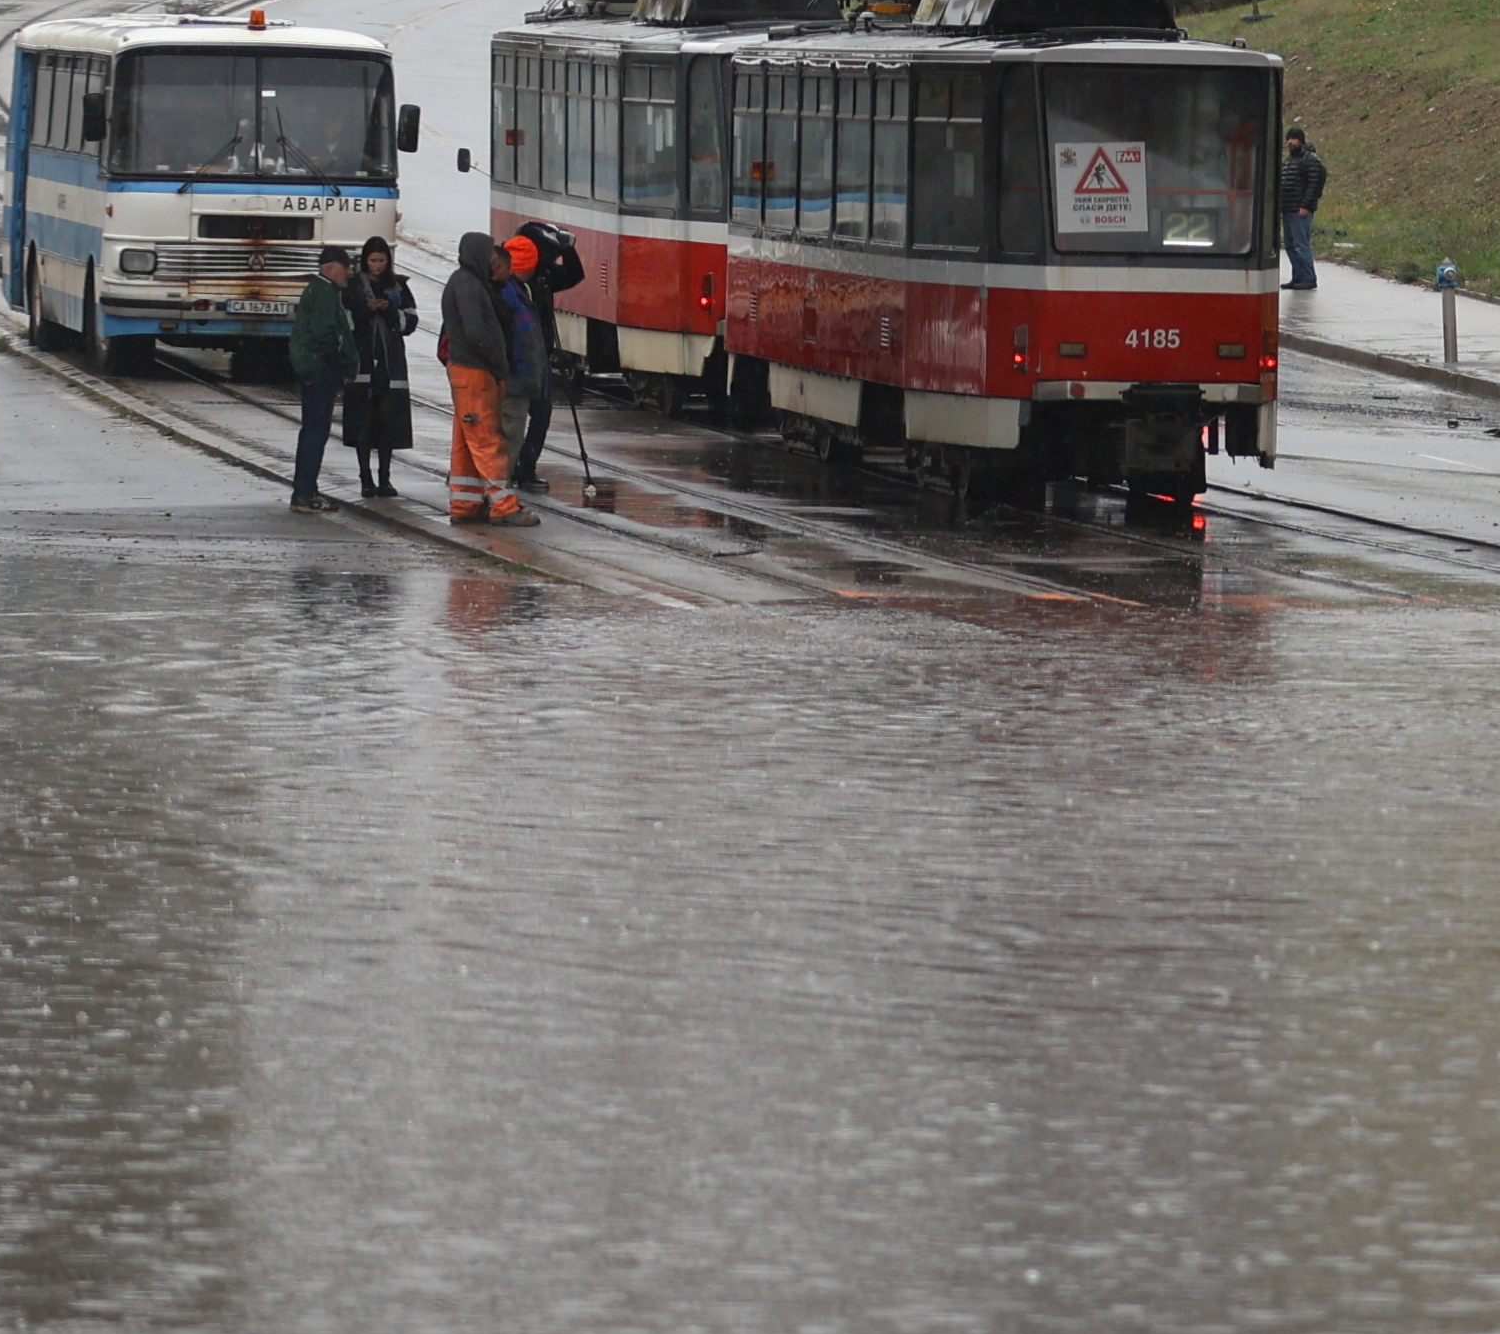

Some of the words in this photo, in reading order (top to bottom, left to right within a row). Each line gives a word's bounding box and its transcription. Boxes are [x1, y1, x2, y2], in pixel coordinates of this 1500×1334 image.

[283, 196, 376, 213] АВАРИЕН
[1074, 195, 1092, 203] УБИЙ
[1094, 195, 1130, 203] СКОРОСТТА
[1106, 204, 1132, 212] ДЕТЕ!
[1094, 216, 1126, 224] BOSCH
[1167, 212, 1210, 241] 22
[233, 301, 245, 312] CA
[249, 302, 272, 313] 1678
[272, 303, 286, 313] AT
[1125, 328, 1181, 348] 4185
